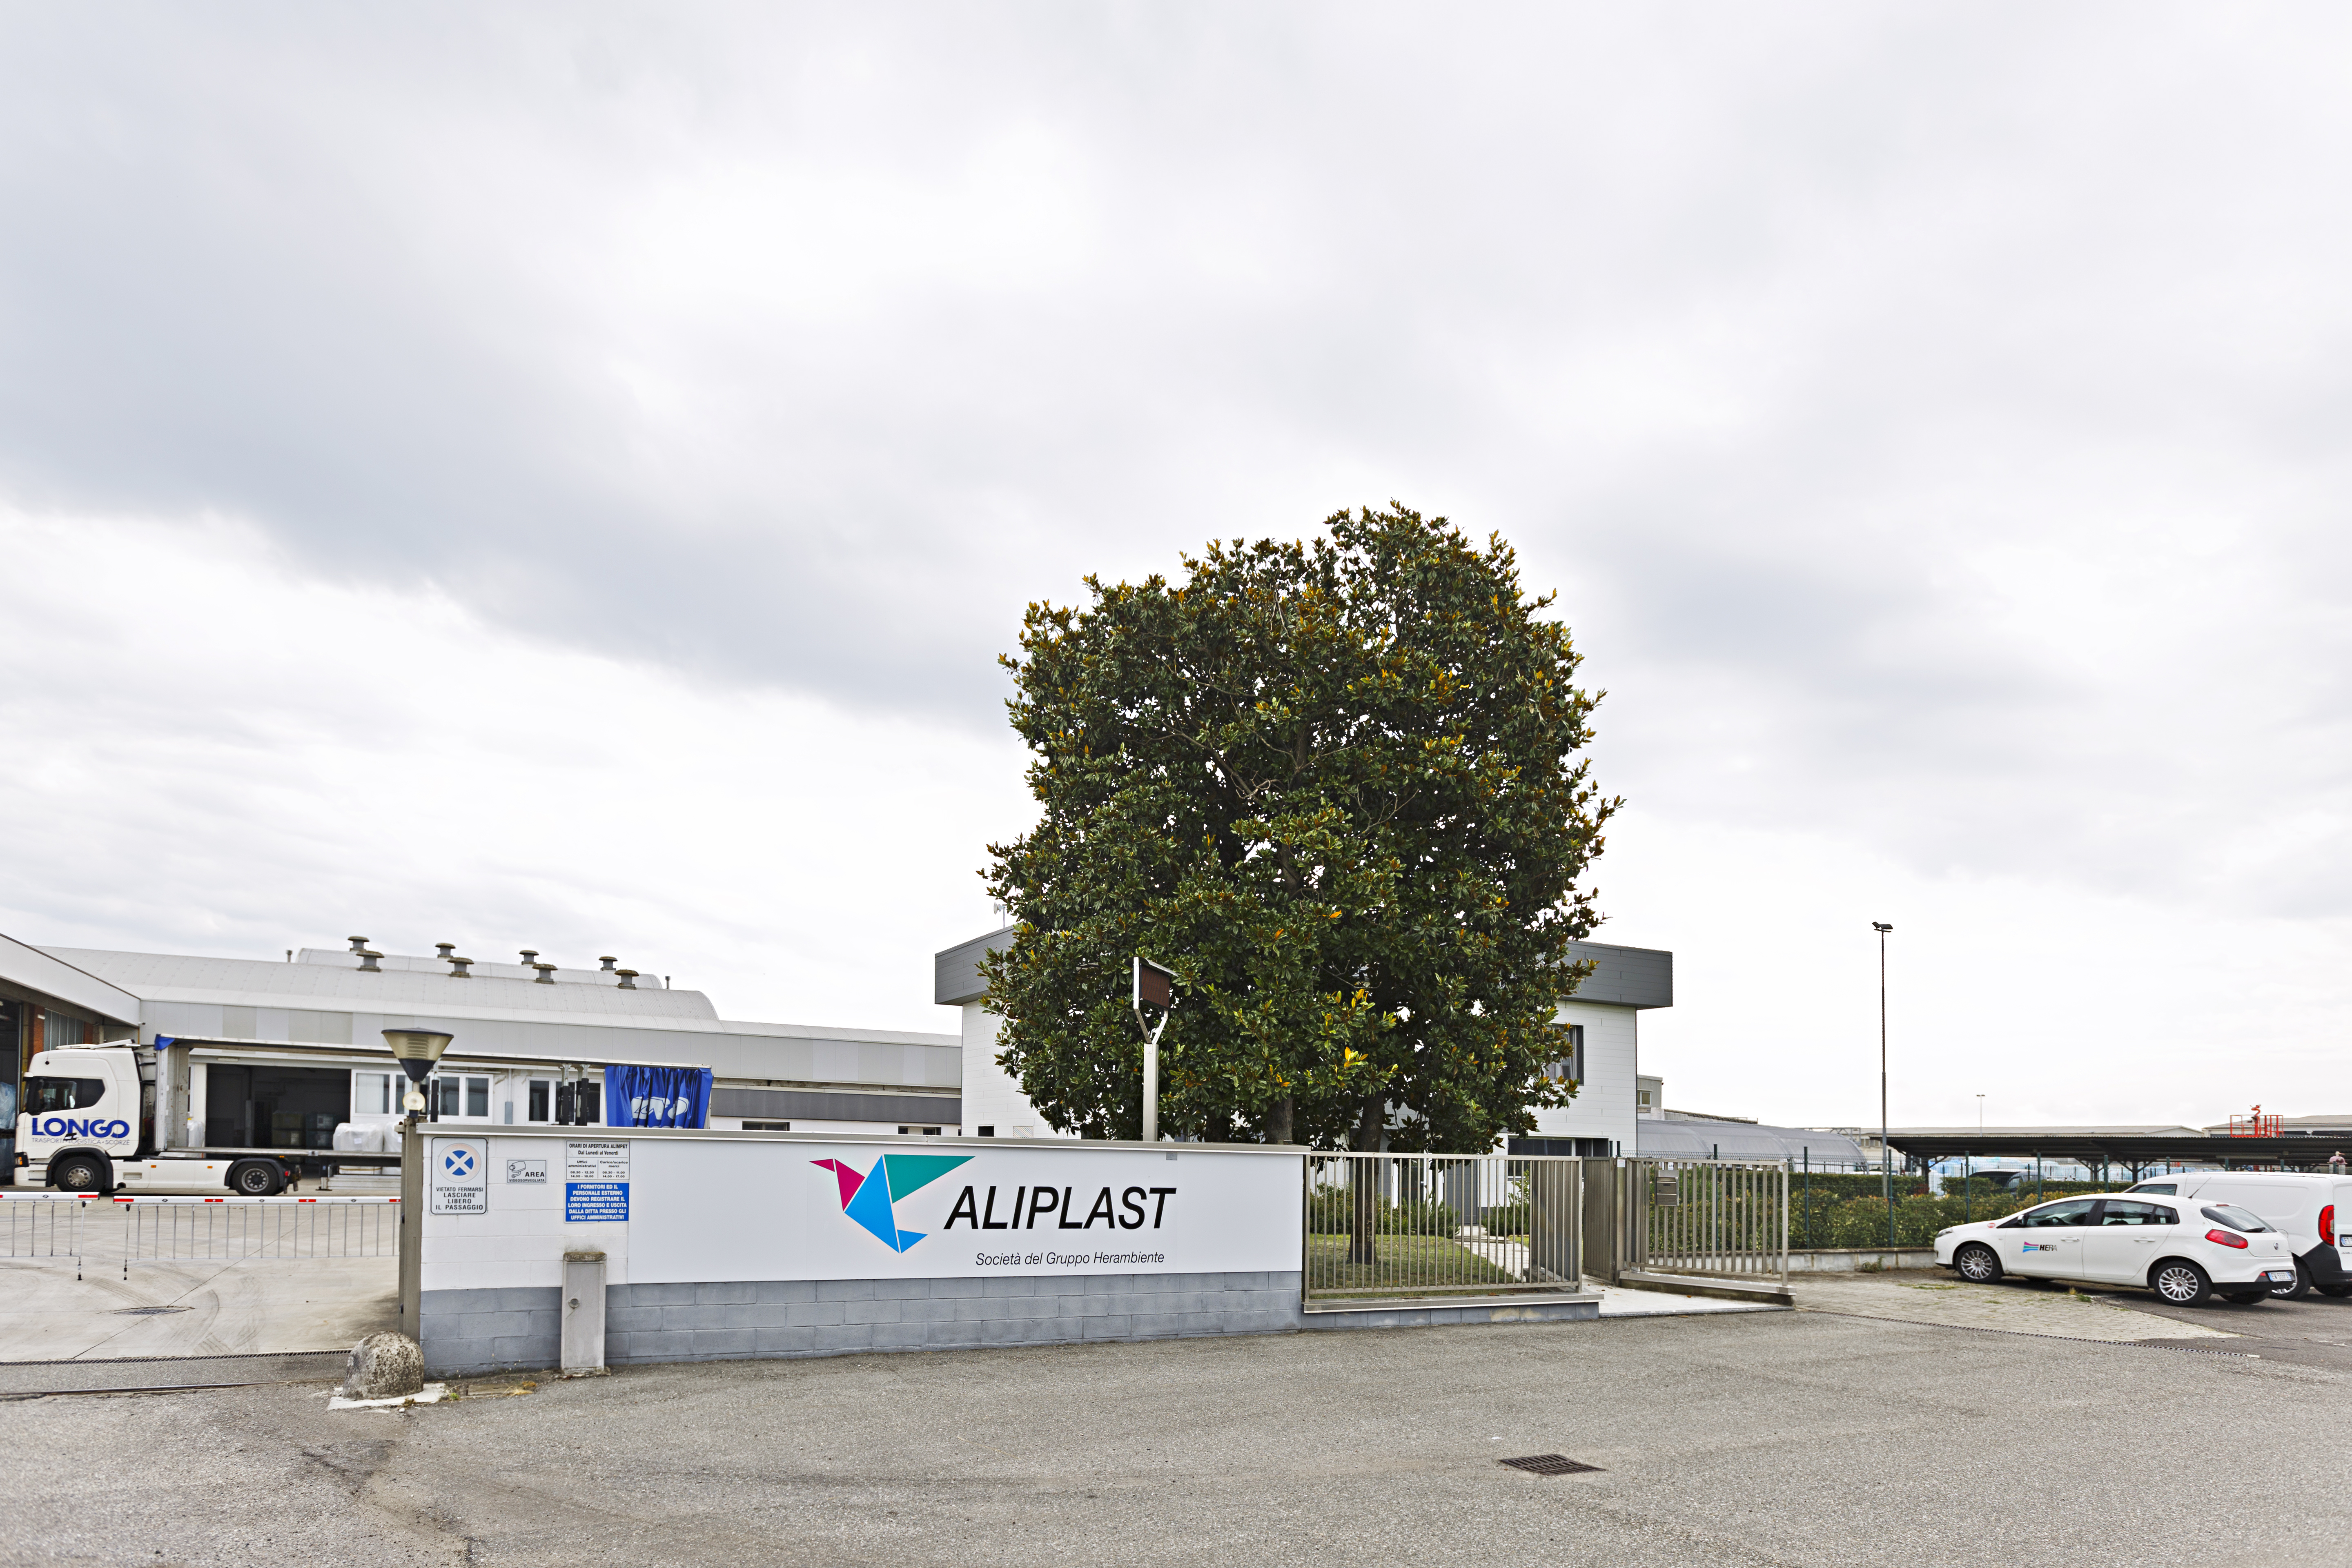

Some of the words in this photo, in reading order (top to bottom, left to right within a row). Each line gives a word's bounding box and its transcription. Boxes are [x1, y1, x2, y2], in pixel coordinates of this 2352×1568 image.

[32, 1118, 130, 1138] LONGO
[943, 1185, 1176, 1230] ALIPLAST
[976, 1252, 1021, 1265] Società
[1025, 1252, 1042, 1265] del
[1046, 1252, 1089, 1267] Gruppo
[1094, 1251, 1164, 1265] Herambiente
